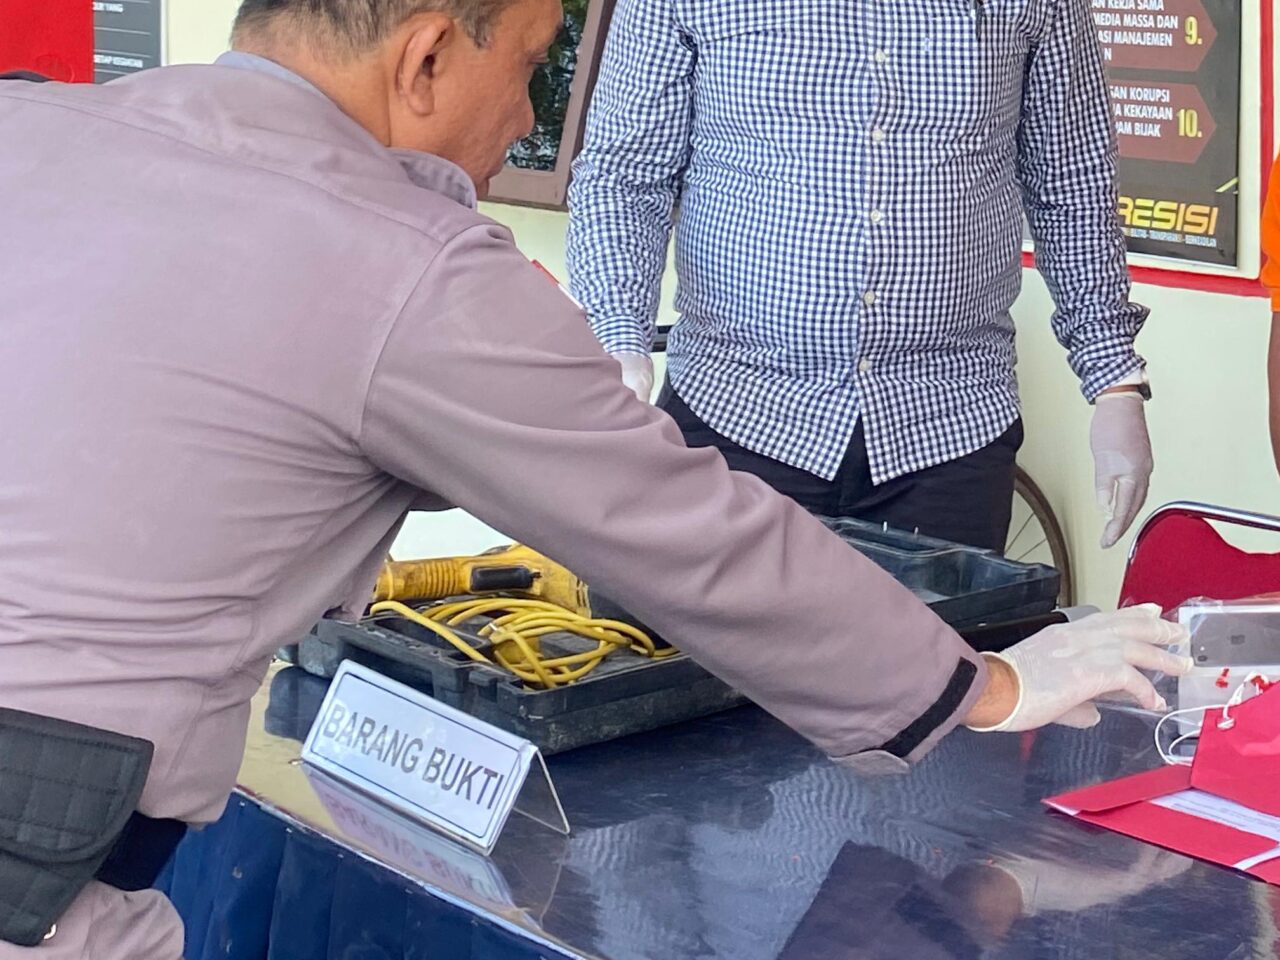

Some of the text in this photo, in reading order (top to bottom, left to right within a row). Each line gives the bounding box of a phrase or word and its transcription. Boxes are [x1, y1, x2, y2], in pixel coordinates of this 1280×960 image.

[1123, 14, 1154, 27] MASSA
[1157, 15, 1178, 29] DAN
[1185, 16, 1203, 45] 9.
[1113, 31, 1172, 46] MANAJEMEN
[1129, 88, 1170, 102] KORUPSI
[1124, 106, 1173, 120] KEKAYAAN
[1134, 123, 1161, 137] BIJAK
[1176, 109, 1202, 138] 10.
[322, 700, 505, 810] BARANG BUKTI
